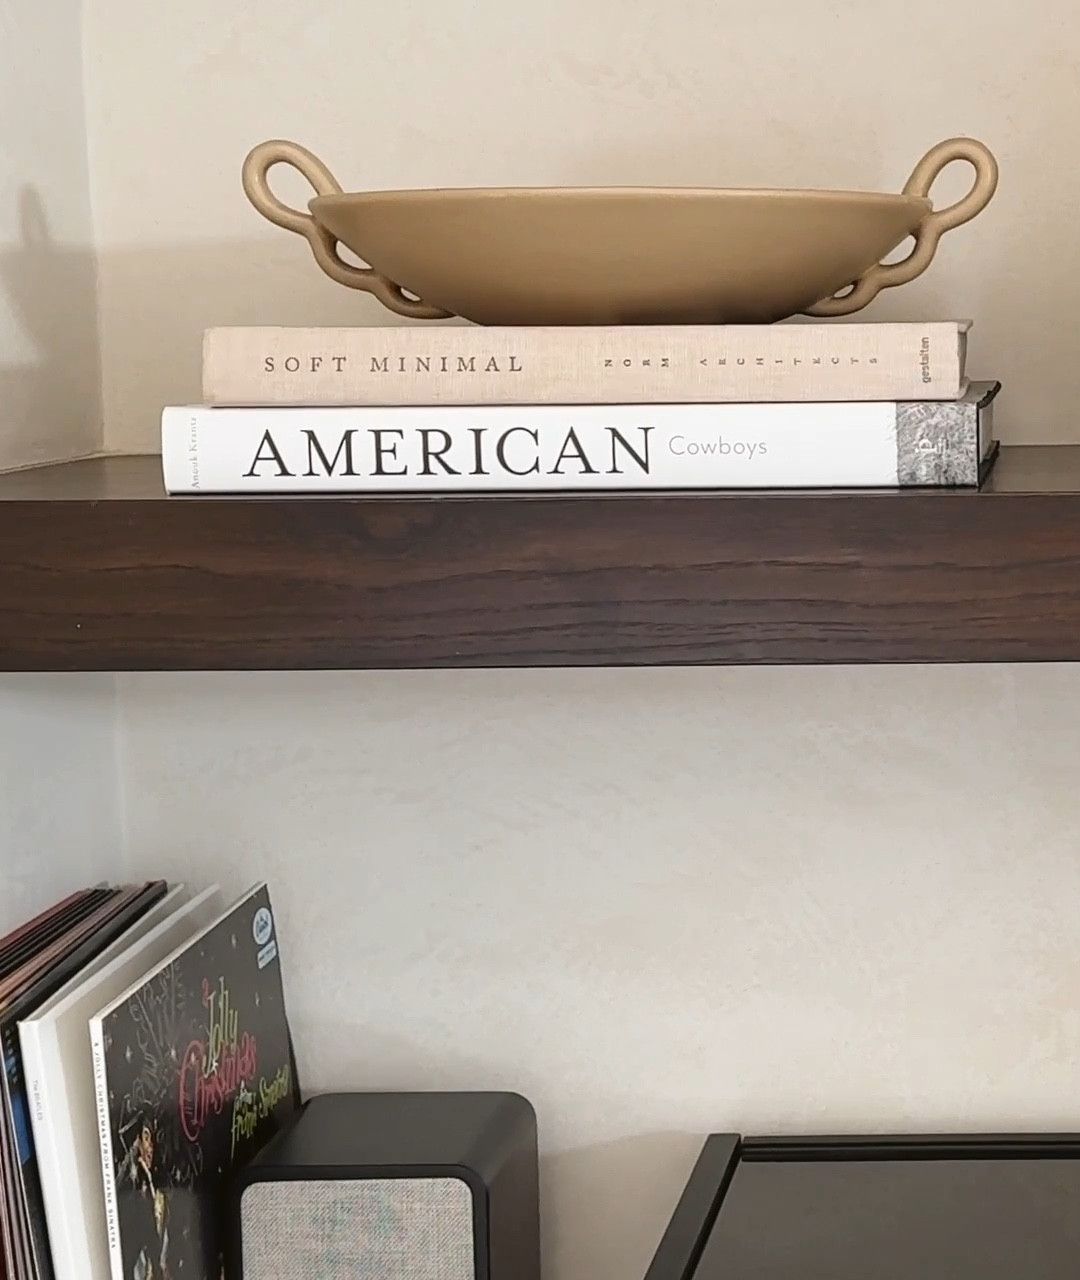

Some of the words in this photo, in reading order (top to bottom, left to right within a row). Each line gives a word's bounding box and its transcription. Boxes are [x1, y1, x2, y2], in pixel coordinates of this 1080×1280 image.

[264, 356, 347, 373] SOFT
[369, 355, 524, 373] MINIMAL
[919, 336, 932, 384] gestalten
[241, 426, 656, 478] AMERICAN
[668, 436, 768, 460] Cowboys
